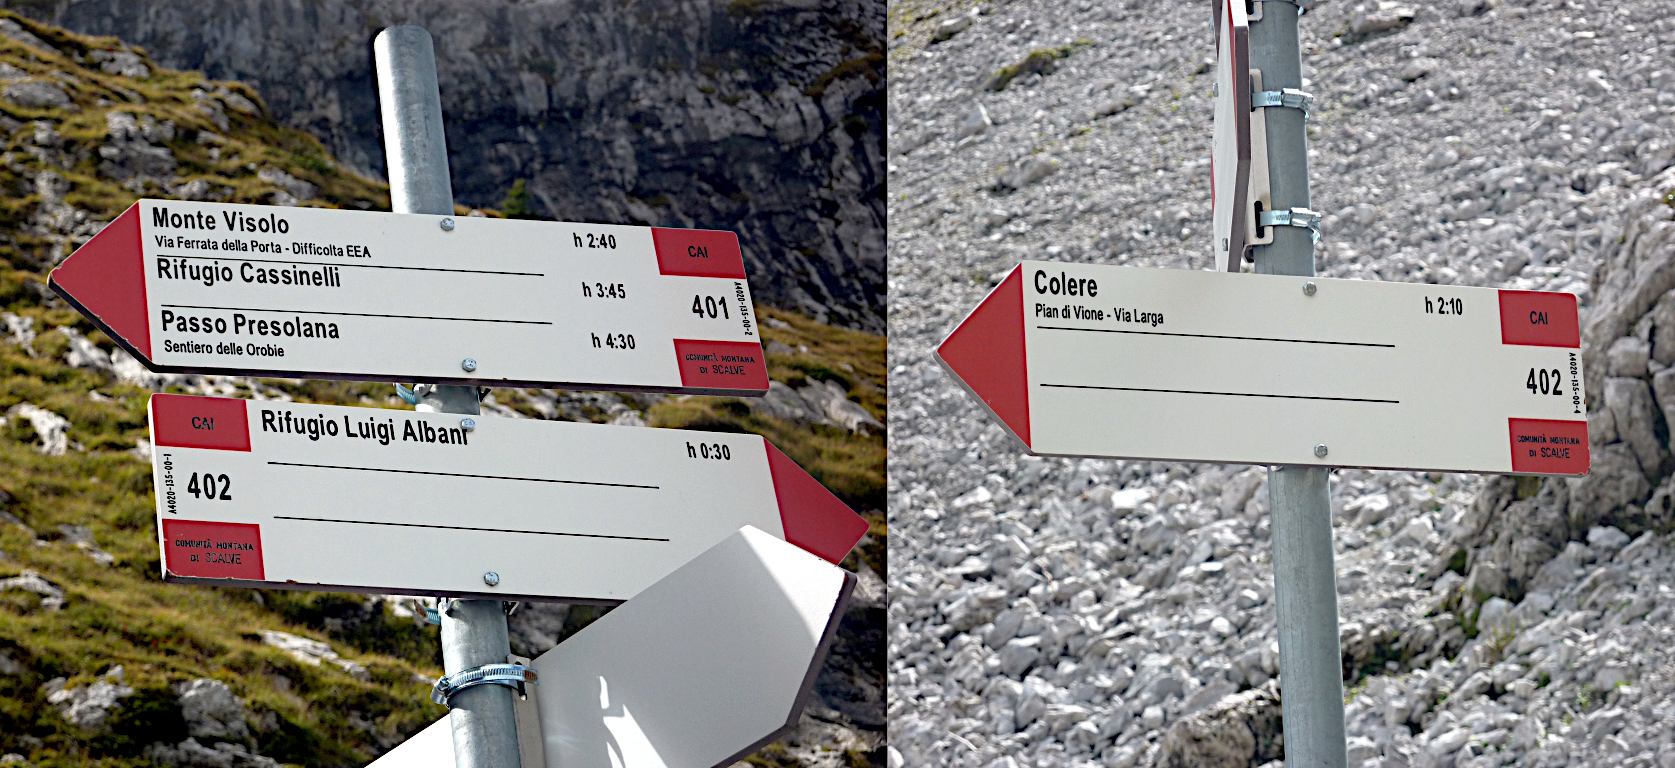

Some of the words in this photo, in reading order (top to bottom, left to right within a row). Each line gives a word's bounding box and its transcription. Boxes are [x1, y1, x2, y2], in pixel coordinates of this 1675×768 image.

[152, 206, 217, 231] Monte
[222, 210, 290, 235] Visolo
[155, 235, 175, 249] Via
[176, 236, 219, 251] Ferrata
[221, 239, 249, 253] della
[250, 240, 282, 255] Porta
[292, 242, 344, 258] Difficolta
[346, 245, 372, 259] EEA
[573, 232, 583, 248] h
[586, 233, 617, 250] 2:40
[687, 245, 709, 259] CAI
[156, 257, 234, 287] Rifugio
[239, 262, 341, 288] Cassinelli
[582, 281, 592, 298] h
[596, 282, 627, 299] 3:45
[1034, 269, 1099, 298] Colere
[691, 294, 730, 320] 401
[1035, 303, 1059, 319] Pian
[1061, 304, 1072, 319] di
[1073, 305, 1104, 321] Vione
[1113, 307, 1132, 322] Via
[1134, 308, 1165, 328] Larga
[1425, 296, 1434, 314] h
[1437, 297, 1464, 316] 2:10
[161, 309, 227, 335] Passo
[233, 313, 340, 339] Presolana
[1529, 311, 1549, 325] CAI
[164, 339, 213, 355] Sentiero
[215, 341, 244, 356] delle
[246, 343, 286, 358] Orobie
[591, 332, 601, 349] h
[605, 333, 637, 350] 4:30
[712, 364, 747, 376] SCALVE
[1526, 367, 1563, 396] 402
[191, 416, 215, 431] CAI
[261, 409, 340, 441] Rifugio
[345, 415, 396, 446] Luigi
[686, 441, 697, 459] h
[700, 442, 731, 461] 0:30
[1540, 448, 1571, 459] SCALVE
[187, 471, 233, 501] 402
[204, 552, 242, 565] SCALVE
